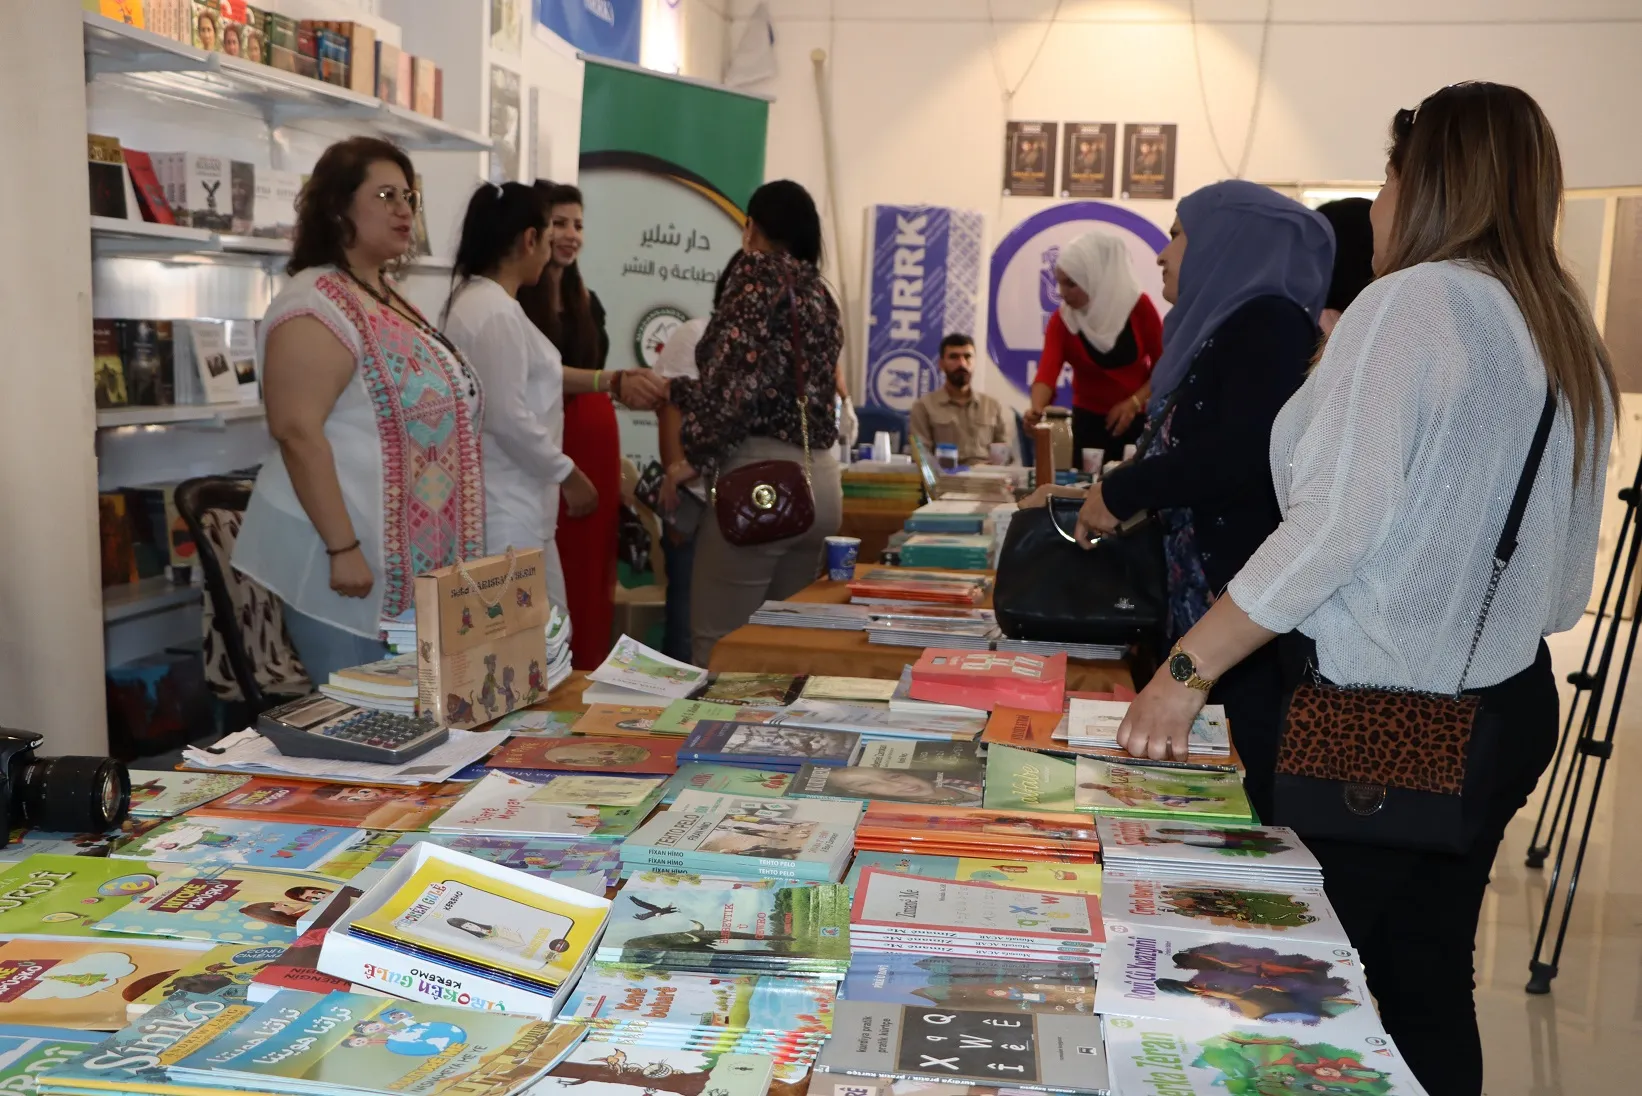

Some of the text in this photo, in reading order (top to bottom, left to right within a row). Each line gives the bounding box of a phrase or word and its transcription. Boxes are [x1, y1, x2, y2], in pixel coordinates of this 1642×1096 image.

[640, 223, 710, 253] دار شلير
[621, 256, 655, 276] النشر
[890, 213, 928, 341] HRRK
[758, 868, 795, 877] TEHTO PELO
[759, 859, 796, 868] TEHTO PELO
[364, 963, 413, 988] GULÊ
[410, 968, 462, 989] KEREMO
[1124, 980, 1156, 1001] Rovî
[923, 1013, 956, 1024] Q
[982, 1018, 1021, 1028] Ê
[1131, 1032, 1184, 1071] Zêran
